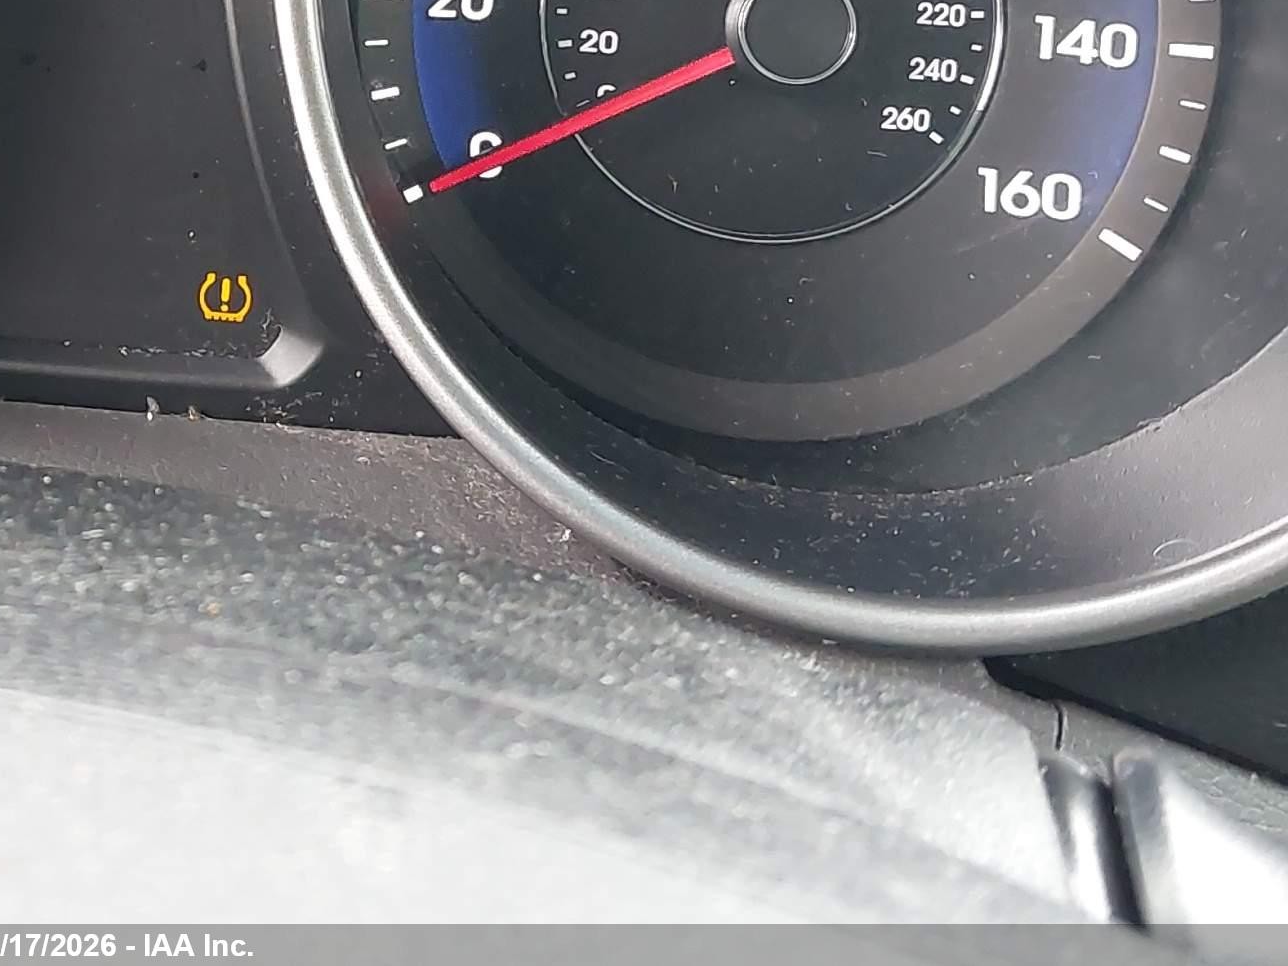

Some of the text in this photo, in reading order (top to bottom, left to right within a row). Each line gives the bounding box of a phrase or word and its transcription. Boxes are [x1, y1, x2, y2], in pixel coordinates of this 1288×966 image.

[916, 1, 966, 28] 220
[579, 29, 619, 55] 20
[1034, 14, 1138, 68] 140
[908, 56, 958, 83] 240
[880, 106, 931, 132] 260
[978, 167, 1082, 221] 160
